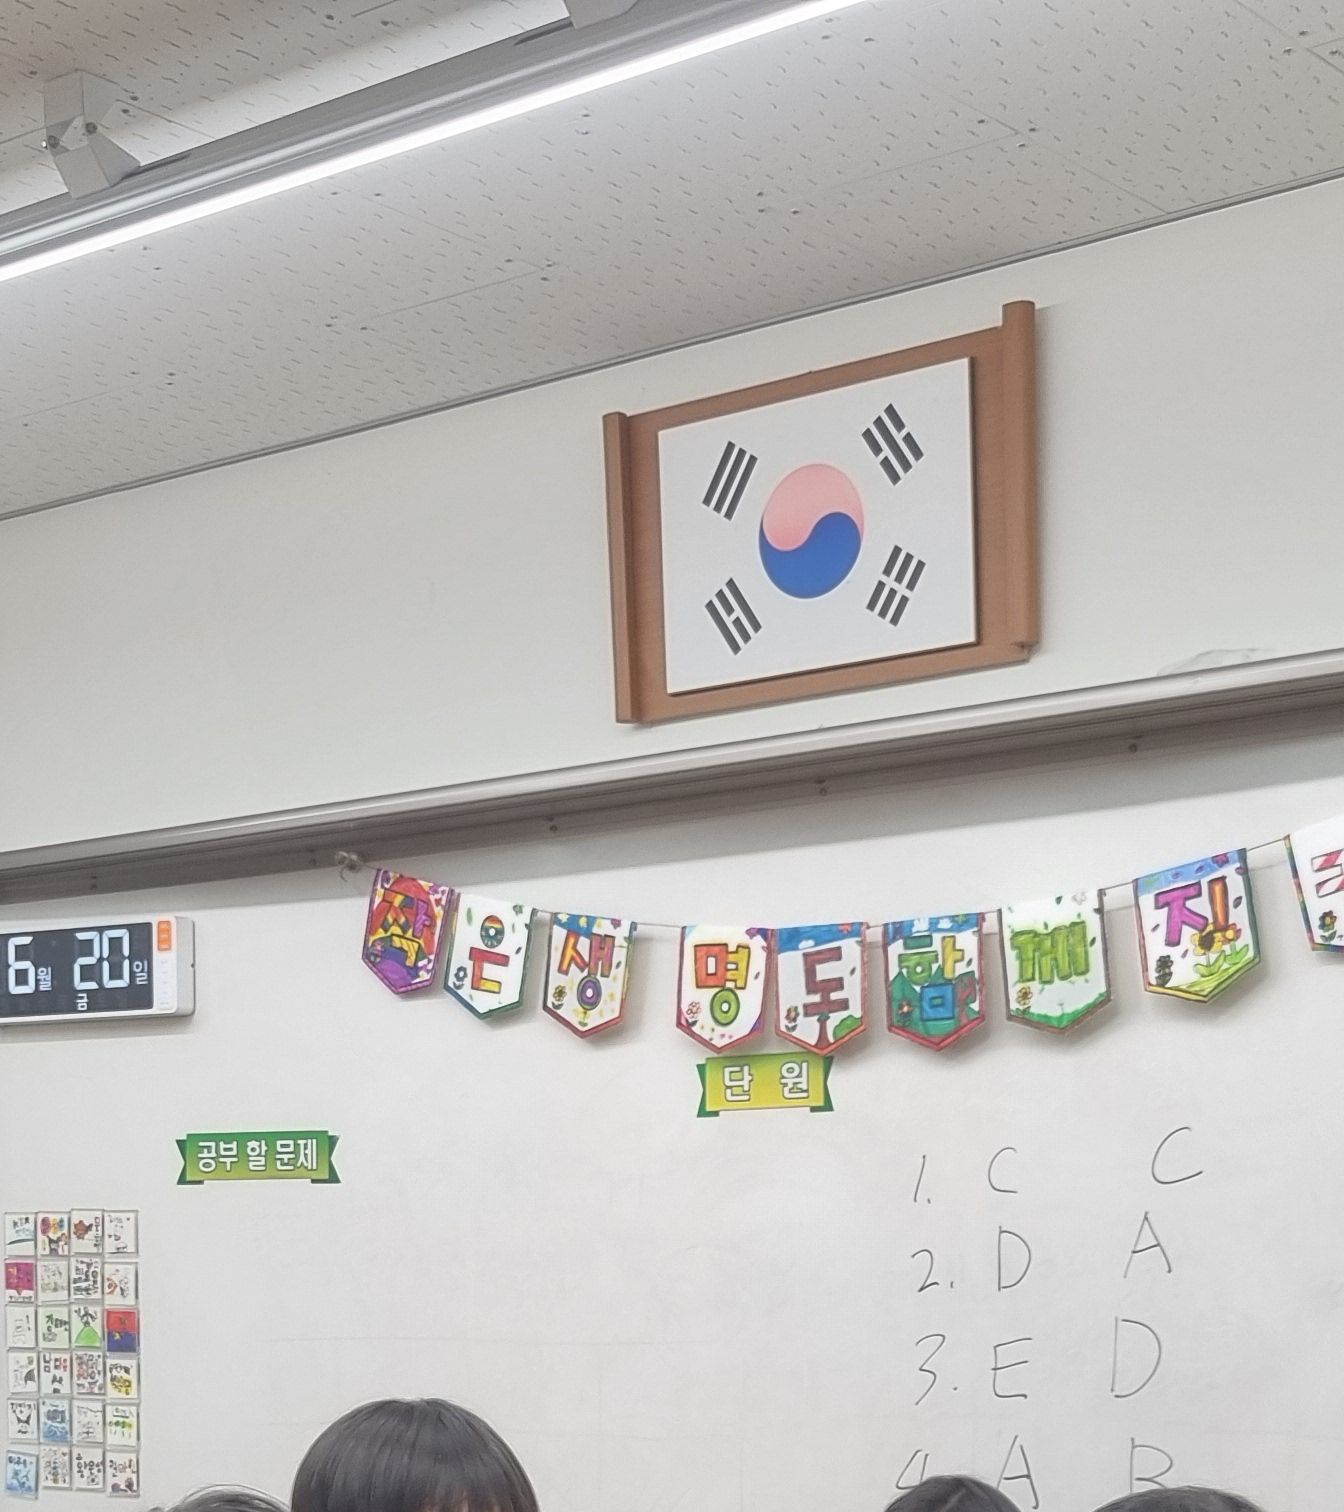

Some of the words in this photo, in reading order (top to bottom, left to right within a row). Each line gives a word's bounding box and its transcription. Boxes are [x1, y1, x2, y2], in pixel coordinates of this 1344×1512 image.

[197, 1140, 239, 1172] 공부
[246, 1140, 267, 1171] 할
[275, 1138, 318, 1171] 문제
[988, 1147, 1018, 1194] C
[1152, 1126, 1203, 1185] C
[997, 1225, 1032, 1292] D
[1124, 1211, 1172, 1279] A
[991, 1337, 1033, 1399] E
[1110, 1316, 1162, 1398] D
